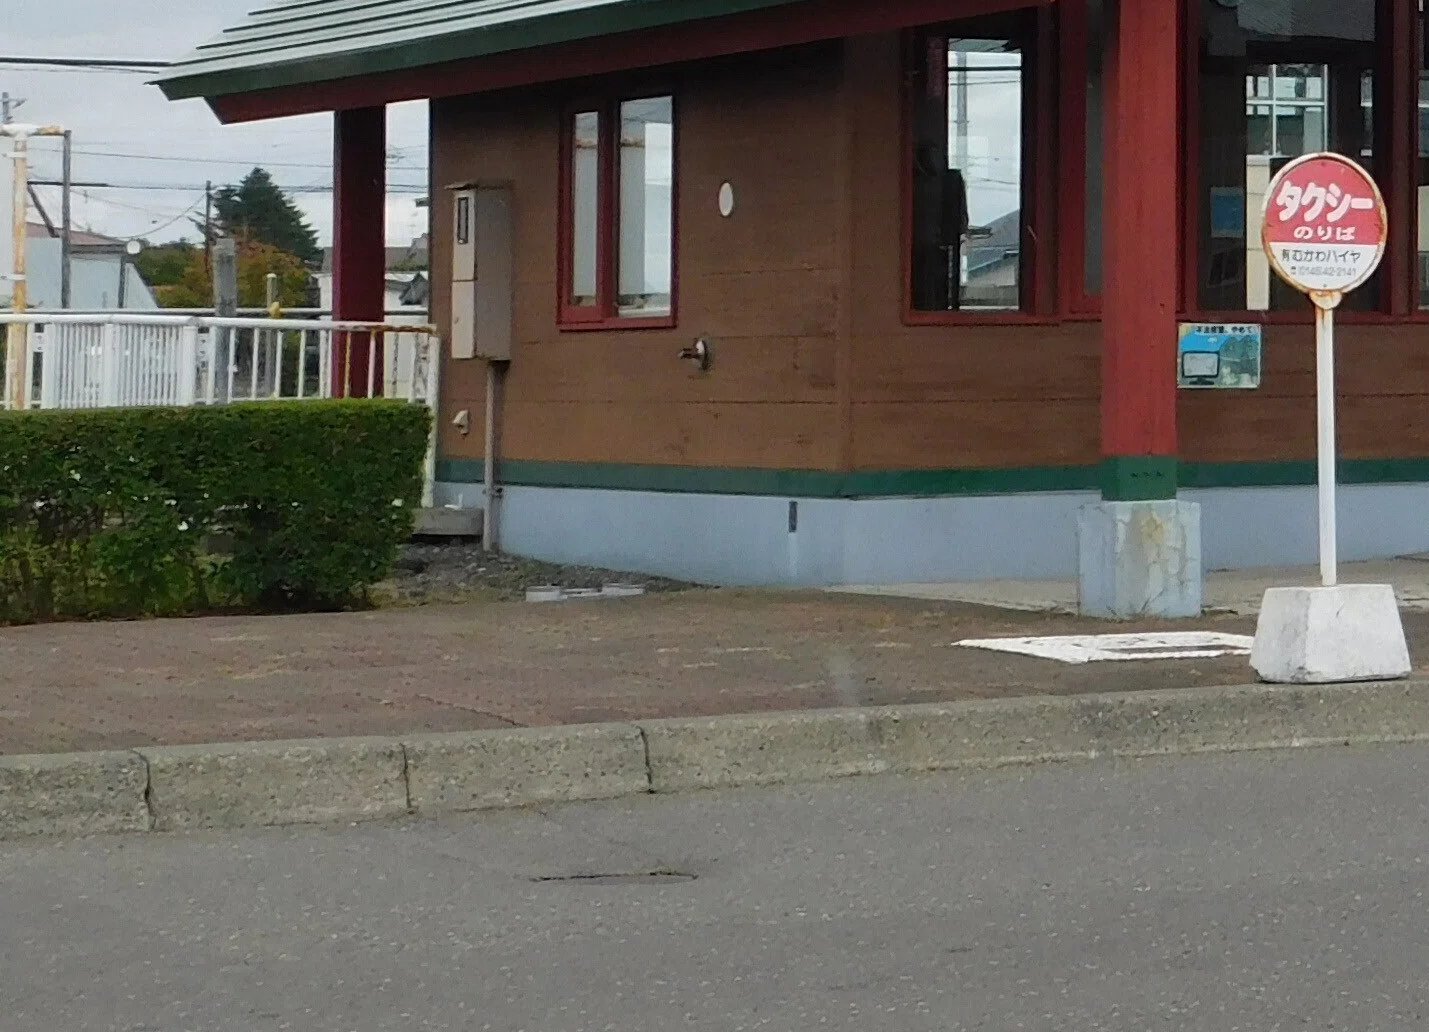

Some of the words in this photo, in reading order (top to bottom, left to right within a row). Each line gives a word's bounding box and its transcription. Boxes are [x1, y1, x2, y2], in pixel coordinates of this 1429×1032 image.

[1276, 180, 1374, 223] タクシー
[1293, 225, 1356, 241] のりば
